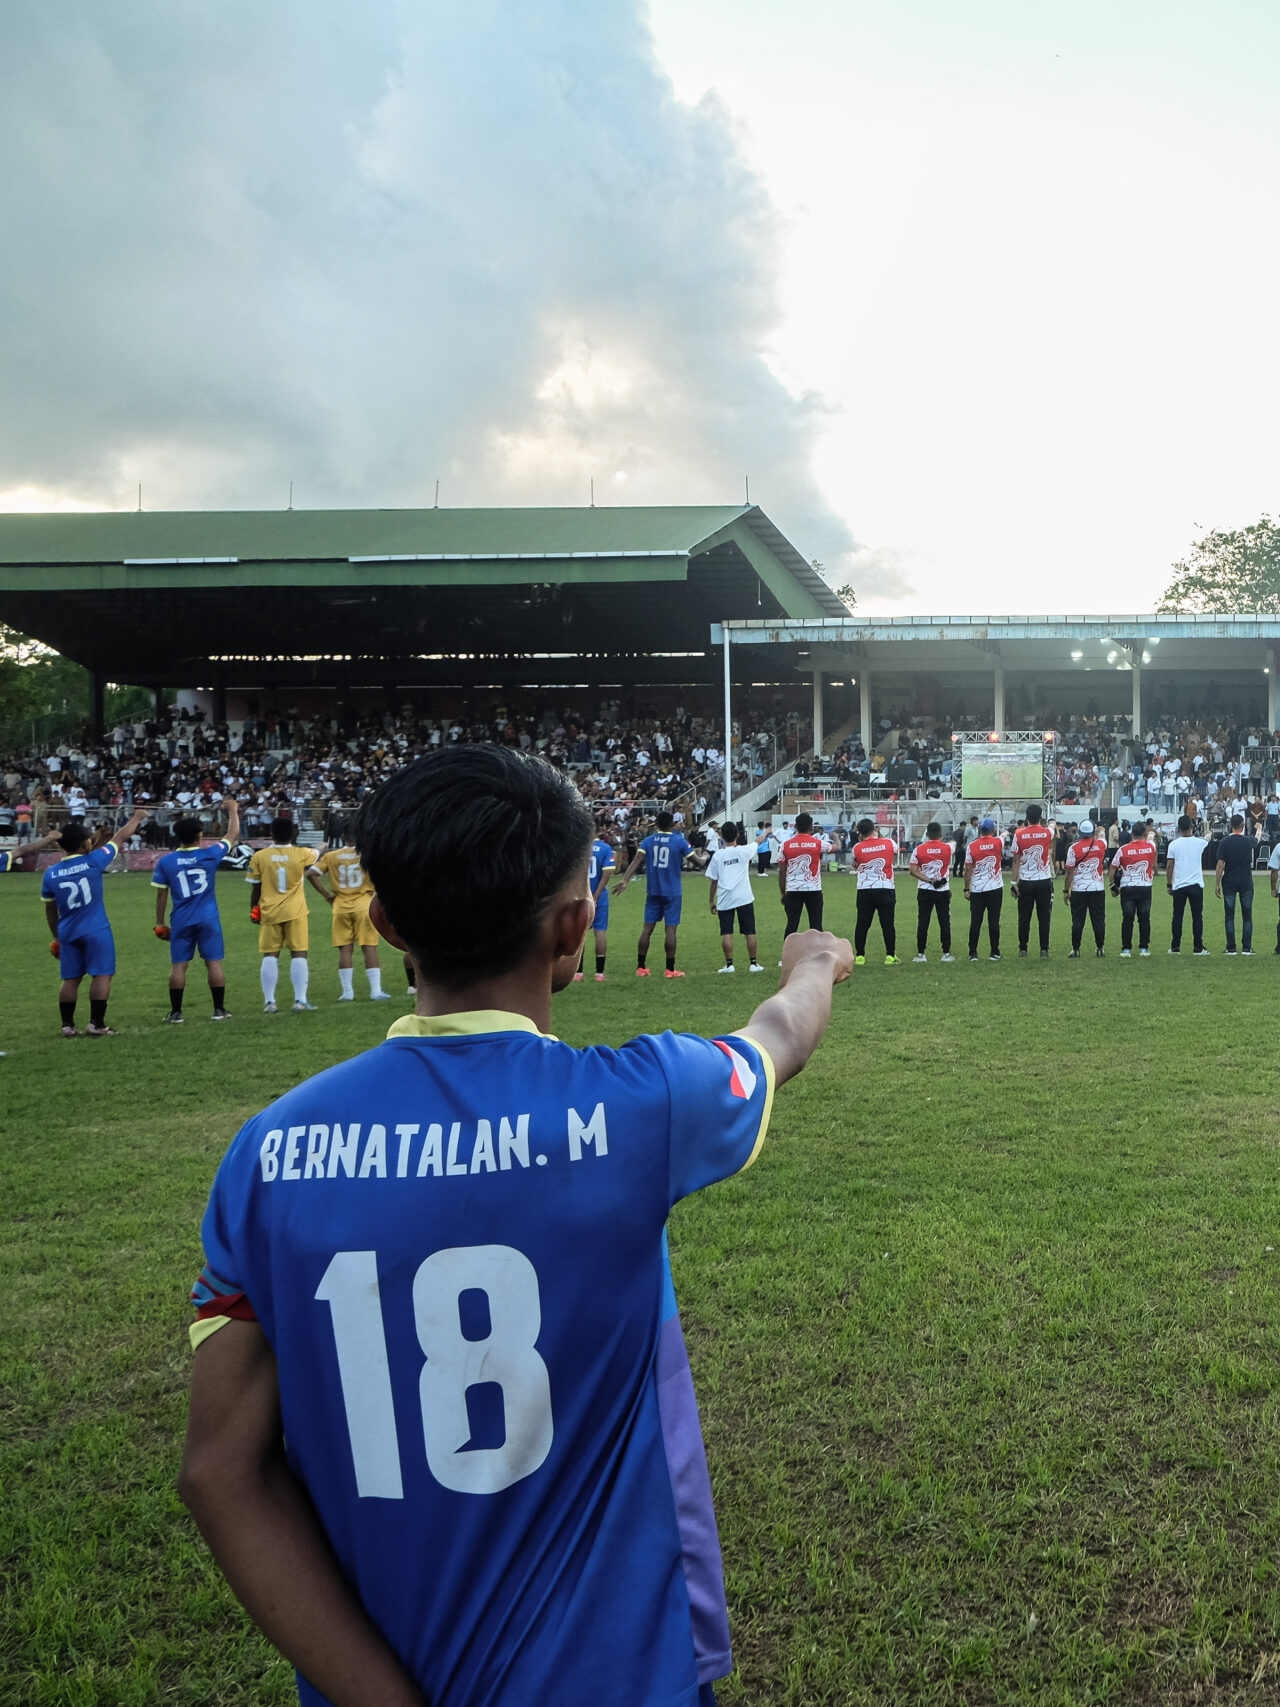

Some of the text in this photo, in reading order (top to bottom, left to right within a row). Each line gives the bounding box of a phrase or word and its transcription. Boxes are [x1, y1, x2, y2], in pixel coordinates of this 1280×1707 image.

[653, 845, 670, 868] 19
[176, 868, 208, 898] 13
[277, 867, 287, 893] 1
[338, 863, 363, 889] 16
[59, 877, 92, 909] 21
[261, 1102, 609, 1182] BERNATALAN. M
[314, 1244, 554, 1499] 18
